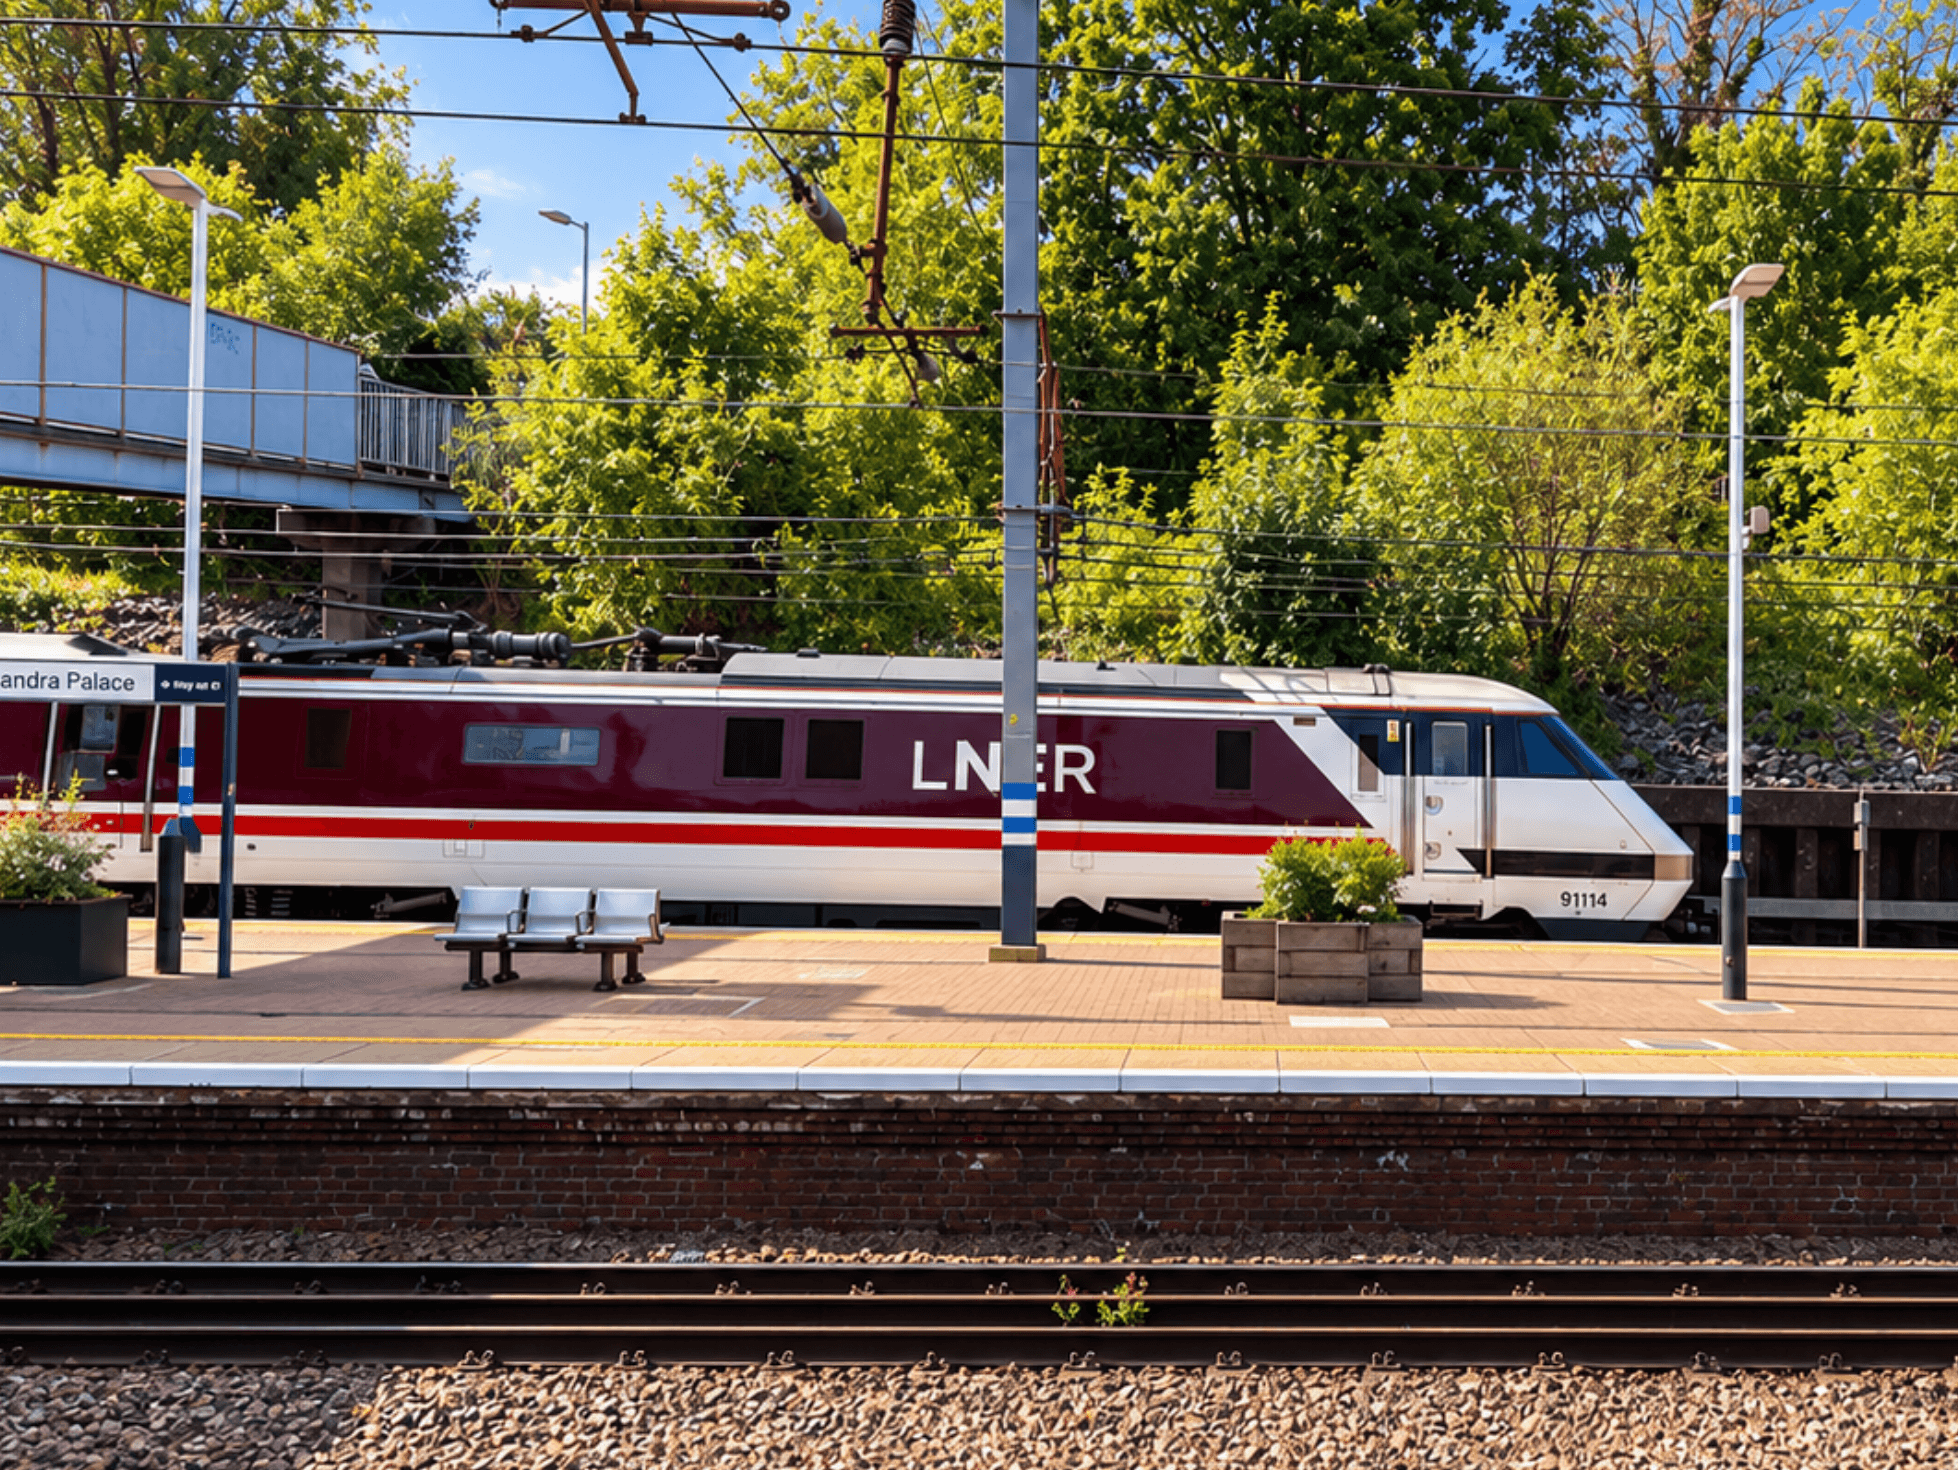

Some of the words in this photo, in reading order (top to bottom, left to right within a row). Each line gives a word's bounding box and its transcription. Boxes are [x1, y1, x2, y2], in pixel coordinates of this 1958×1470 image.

[0, 671, 60, 689] andra
[67, 671, 135, 691] Palace
[912, 739, 1097, 794] LNR
[1560, 890, 1608, 908] 91114
